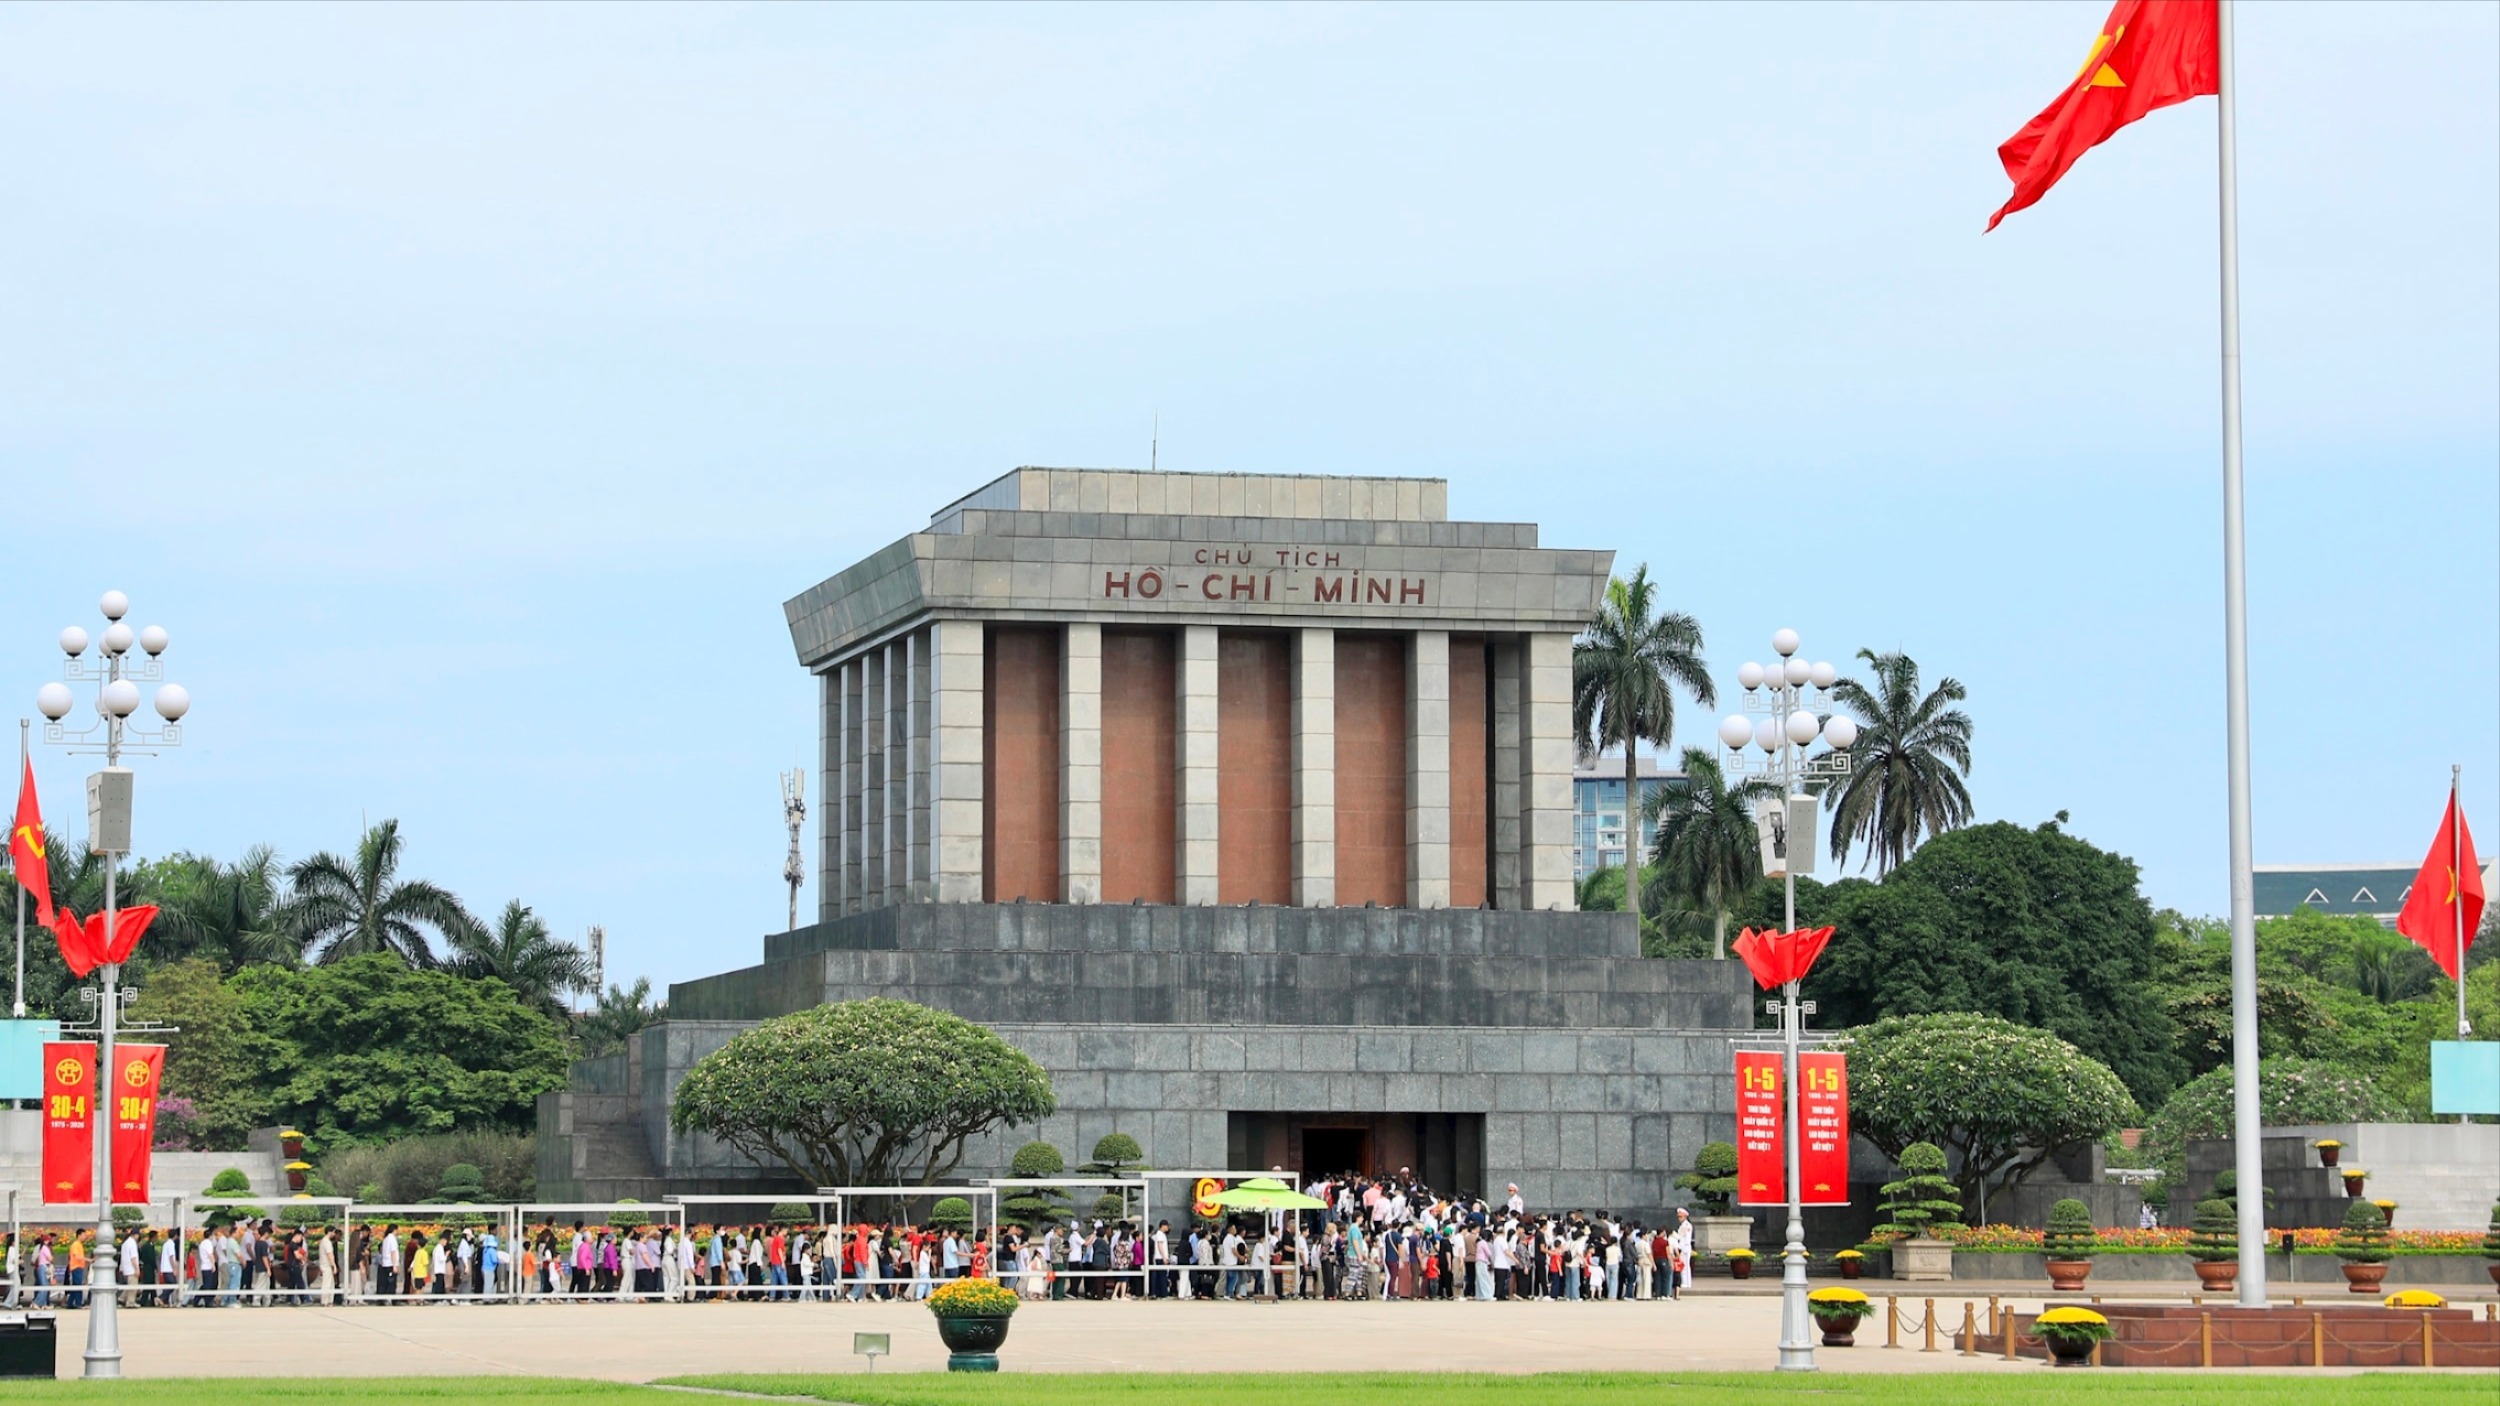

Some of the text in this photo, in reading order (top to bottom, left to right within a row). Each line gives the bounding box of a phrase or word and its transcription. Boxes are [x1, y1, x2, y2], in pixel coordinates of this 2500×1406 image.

[1195, 544, 1252, 565] CHỦ
[1104, 566, 1165, 599] HỒ
[1201, 569, 1276, 601] CHÍ
[1743, 1066, 1775, 1091] 1-5
[1807, 1067, 1839, 1092] 1-5
[51, 1095, 86, 1119] 30-4
[119, 1096, 151, 1121] 30-4
